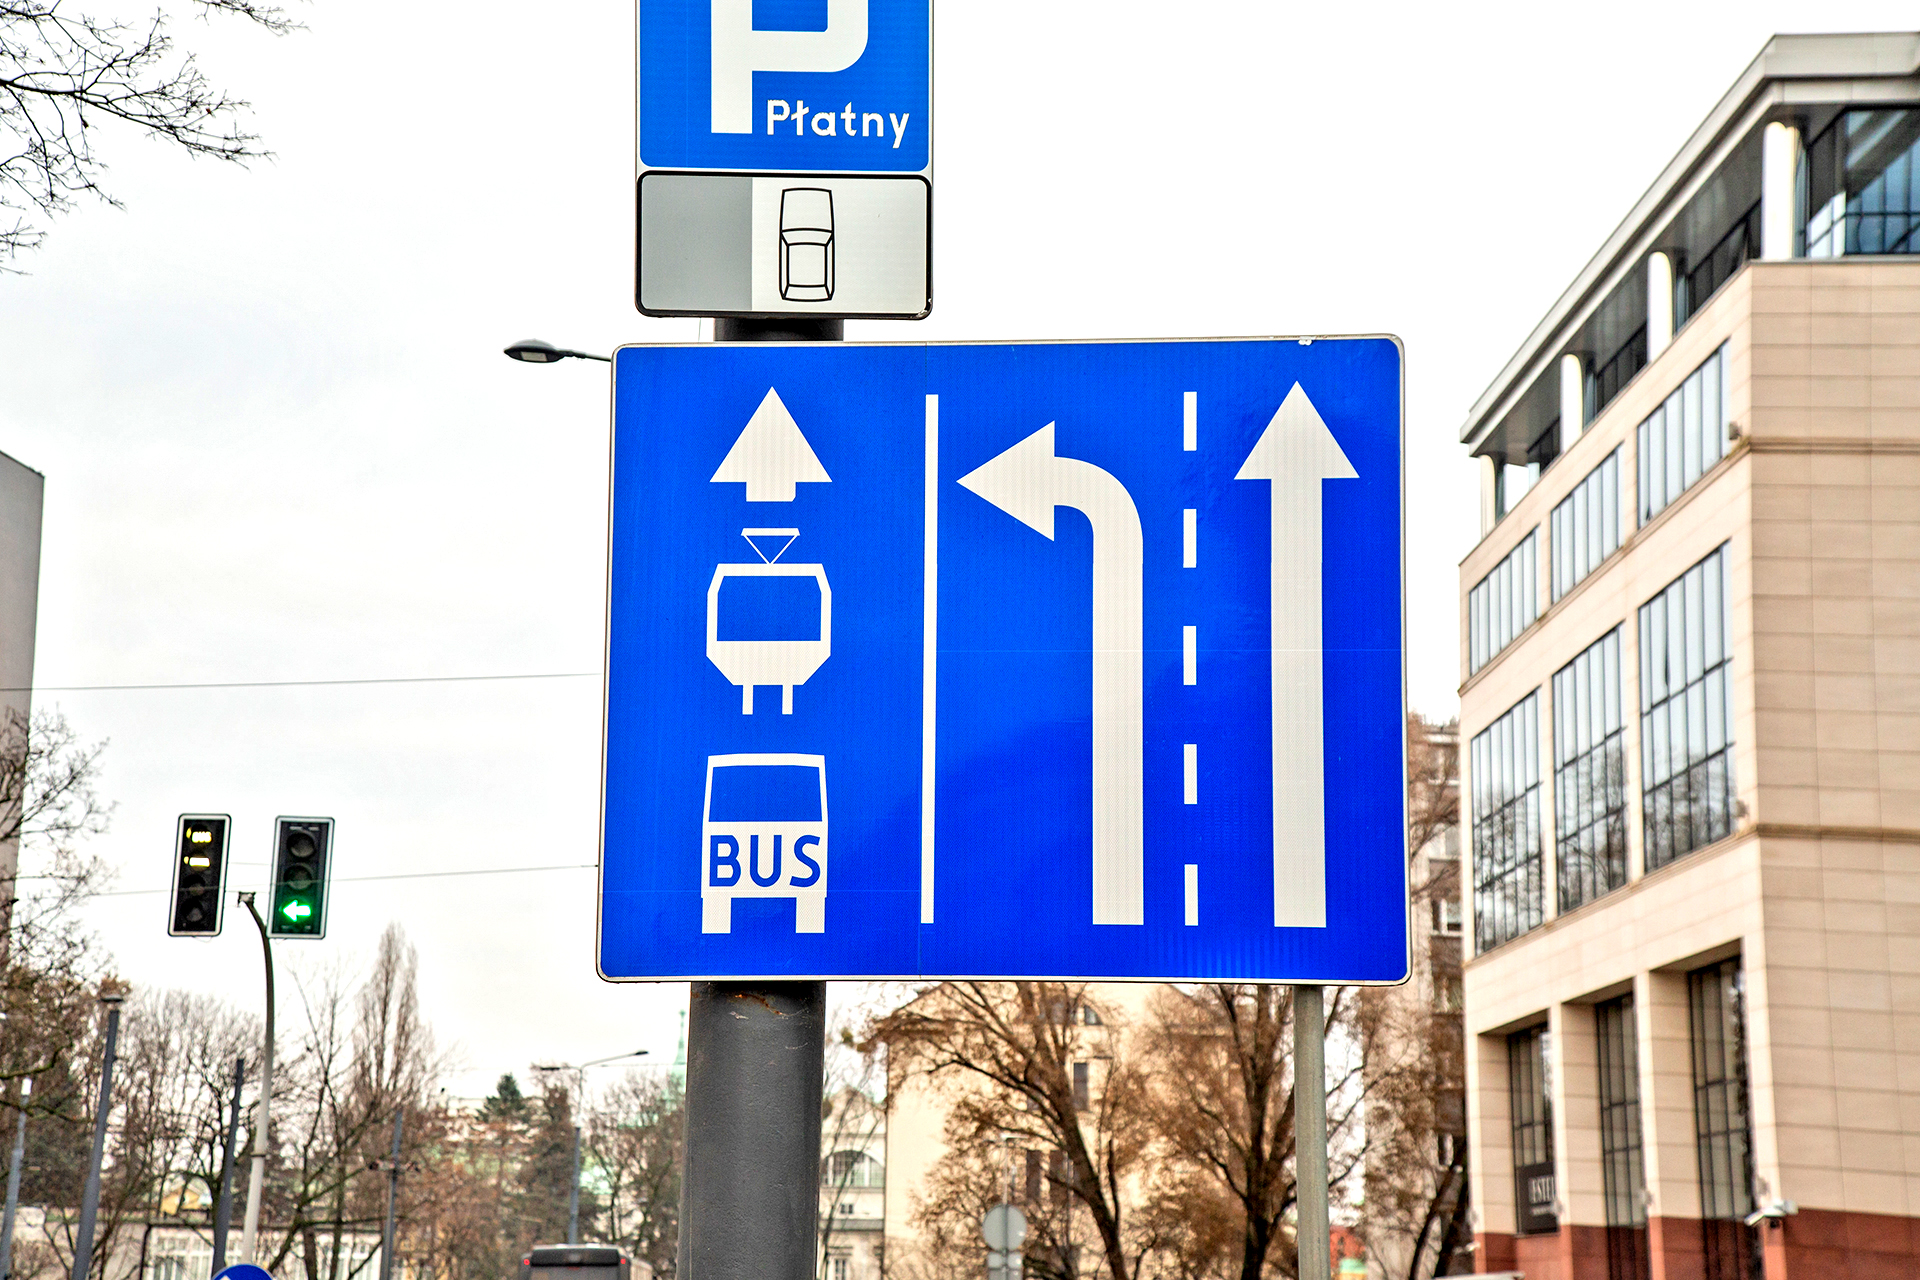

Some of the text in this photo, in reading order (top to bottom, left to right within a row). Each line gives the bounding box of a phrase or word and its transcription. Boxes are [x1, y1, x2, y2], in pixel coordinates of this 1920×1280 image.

[711, 0, 869, 134] P
[767, 99, 910, 149] Płatny
[708, 834, 821, 888] BUS
